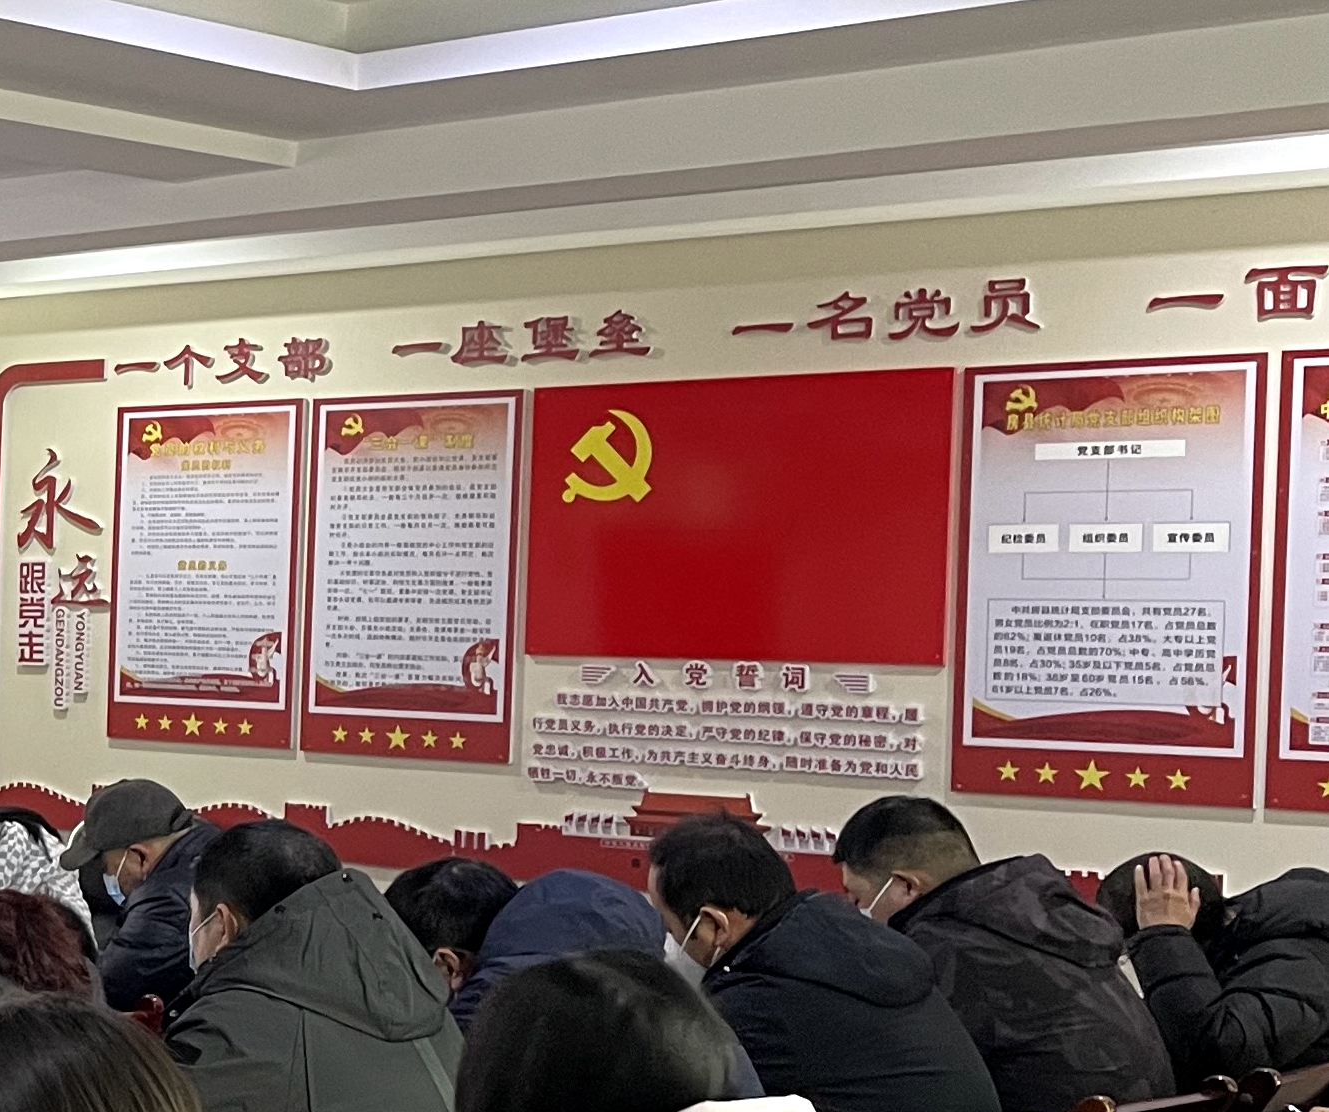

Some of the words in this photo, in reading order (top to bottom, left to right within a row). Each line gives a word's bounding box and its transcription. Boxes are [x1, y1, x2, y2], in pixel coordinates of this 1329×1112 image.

[114, 337, 329, 389] 一个支部
[391, 309, 651, 366] 一座堡垒
[732, 278, 1040, 341] 一名党员
[1147, 264, 1329, 320] 一面
[1077, 444, 1142, 456] 党支部书记
[17, 448, 111, 605] 永远
[1001, 533, 1046, 544] 纪检委员
[1082, 532, 1129, 544] 组织委员
[1167, 532, 1215, 543] 宣传委员
[18, 562, 45, 663] 跟党走
[53, 608, 65, 708] GENDANGZOU
[74, 611, 86, 692] YONGYUAN
[633, 663, 806, 690] 入党誓词
